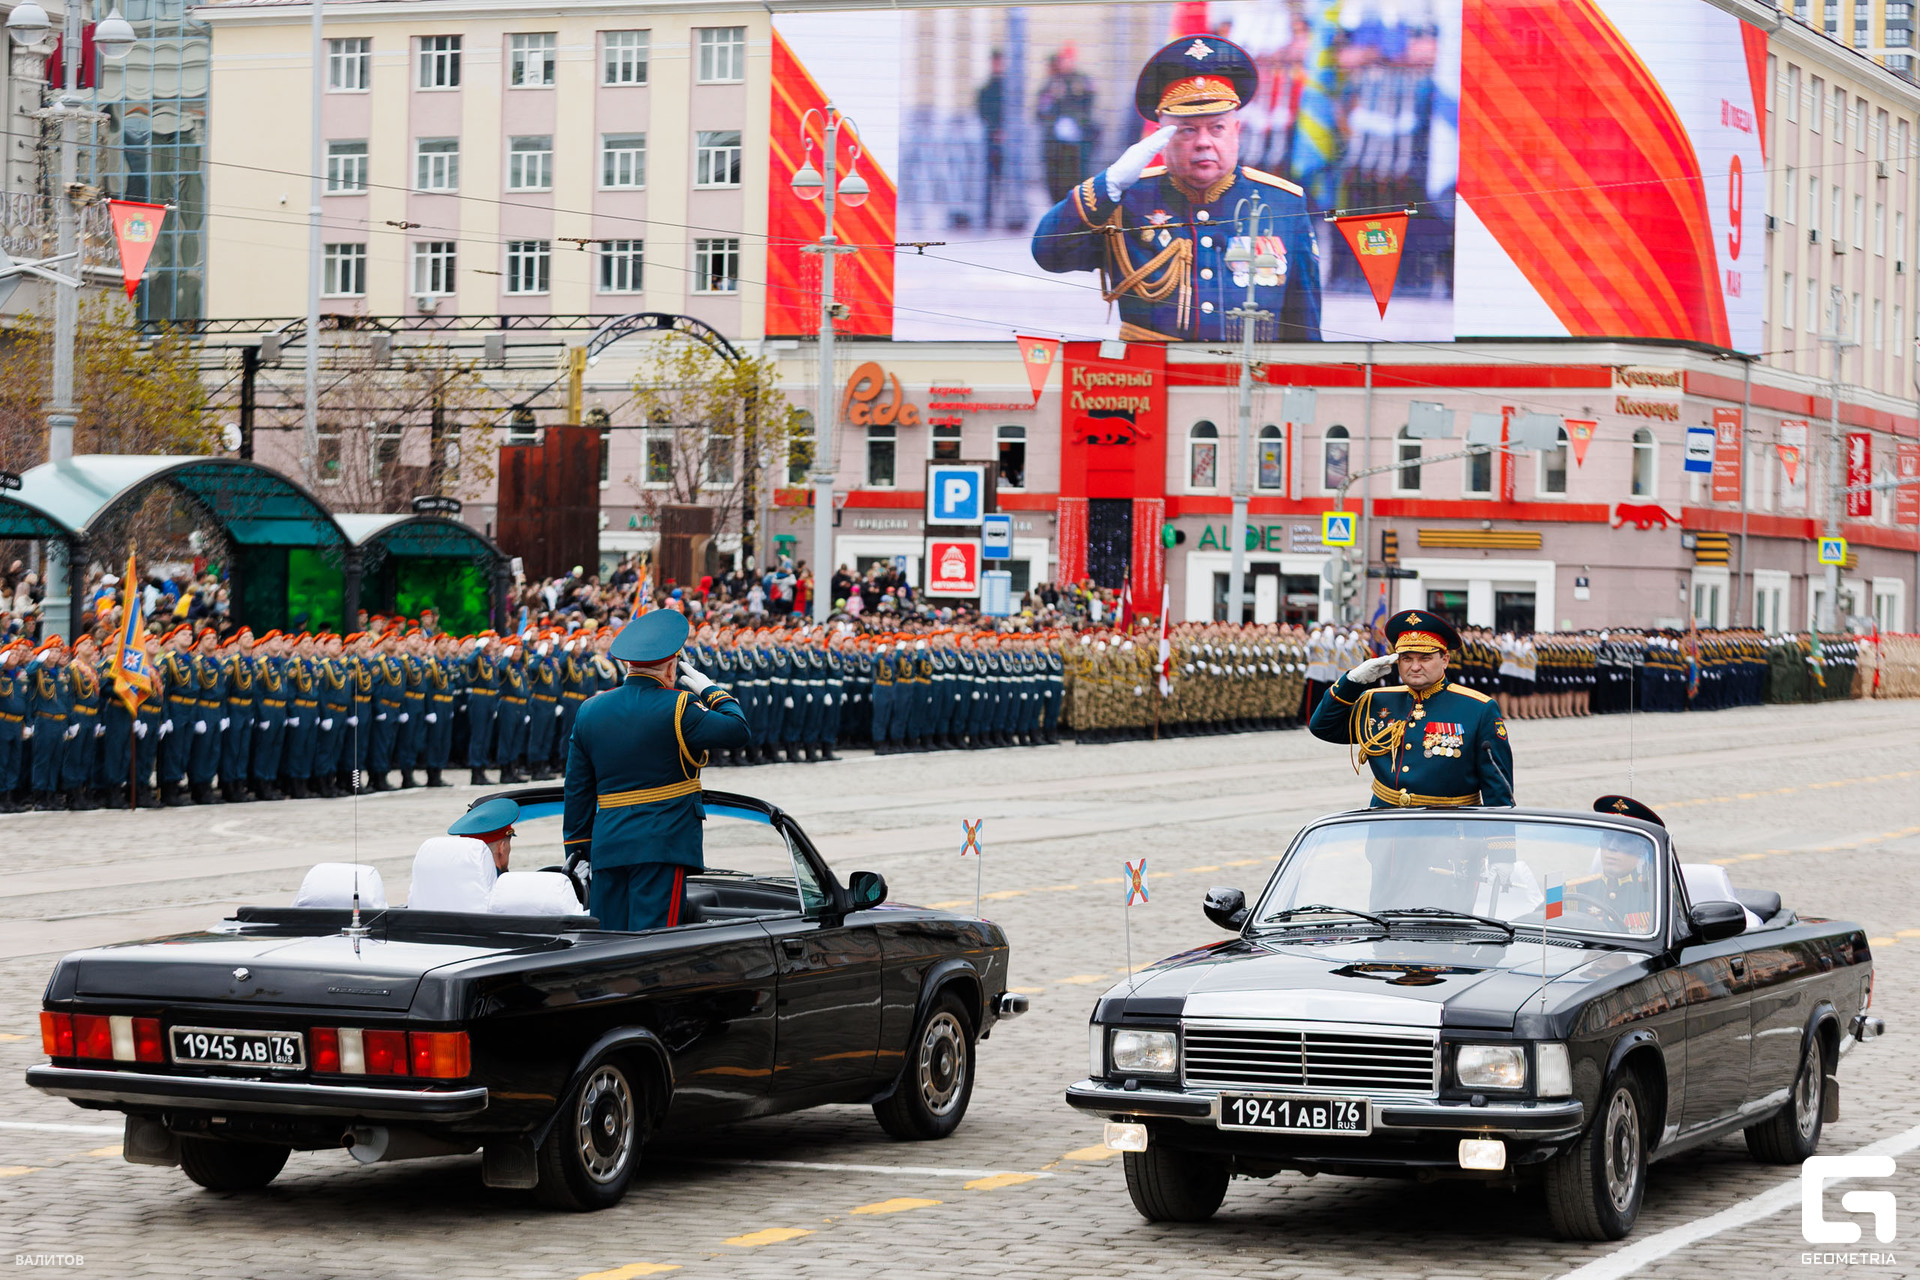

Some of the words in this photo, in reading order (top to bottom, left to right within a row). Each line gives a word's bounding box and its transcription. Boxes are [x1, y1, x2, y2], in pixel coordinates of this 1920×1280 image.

[1728, 154, 1743, 261] 9
[1726, 269, 1741, 298] МАЯ
[1072, 366, 1153, 391] Красный
[1615, 365, 1680, 388] Красный
[1070, 390, 1151, 414] Леопард
[1615, 395, 1679, 421] Леопард
[183, 1033, 237, 1060] 1945
[271, 1037, 295, 1057] 76
[276, 1055, 293, 1064] RUS
[1232, 1098, 1290, 1127] 1941
[1334, 1102, 1360, 1122] 76
[1337, 1121, 1357, 1130] RUS
